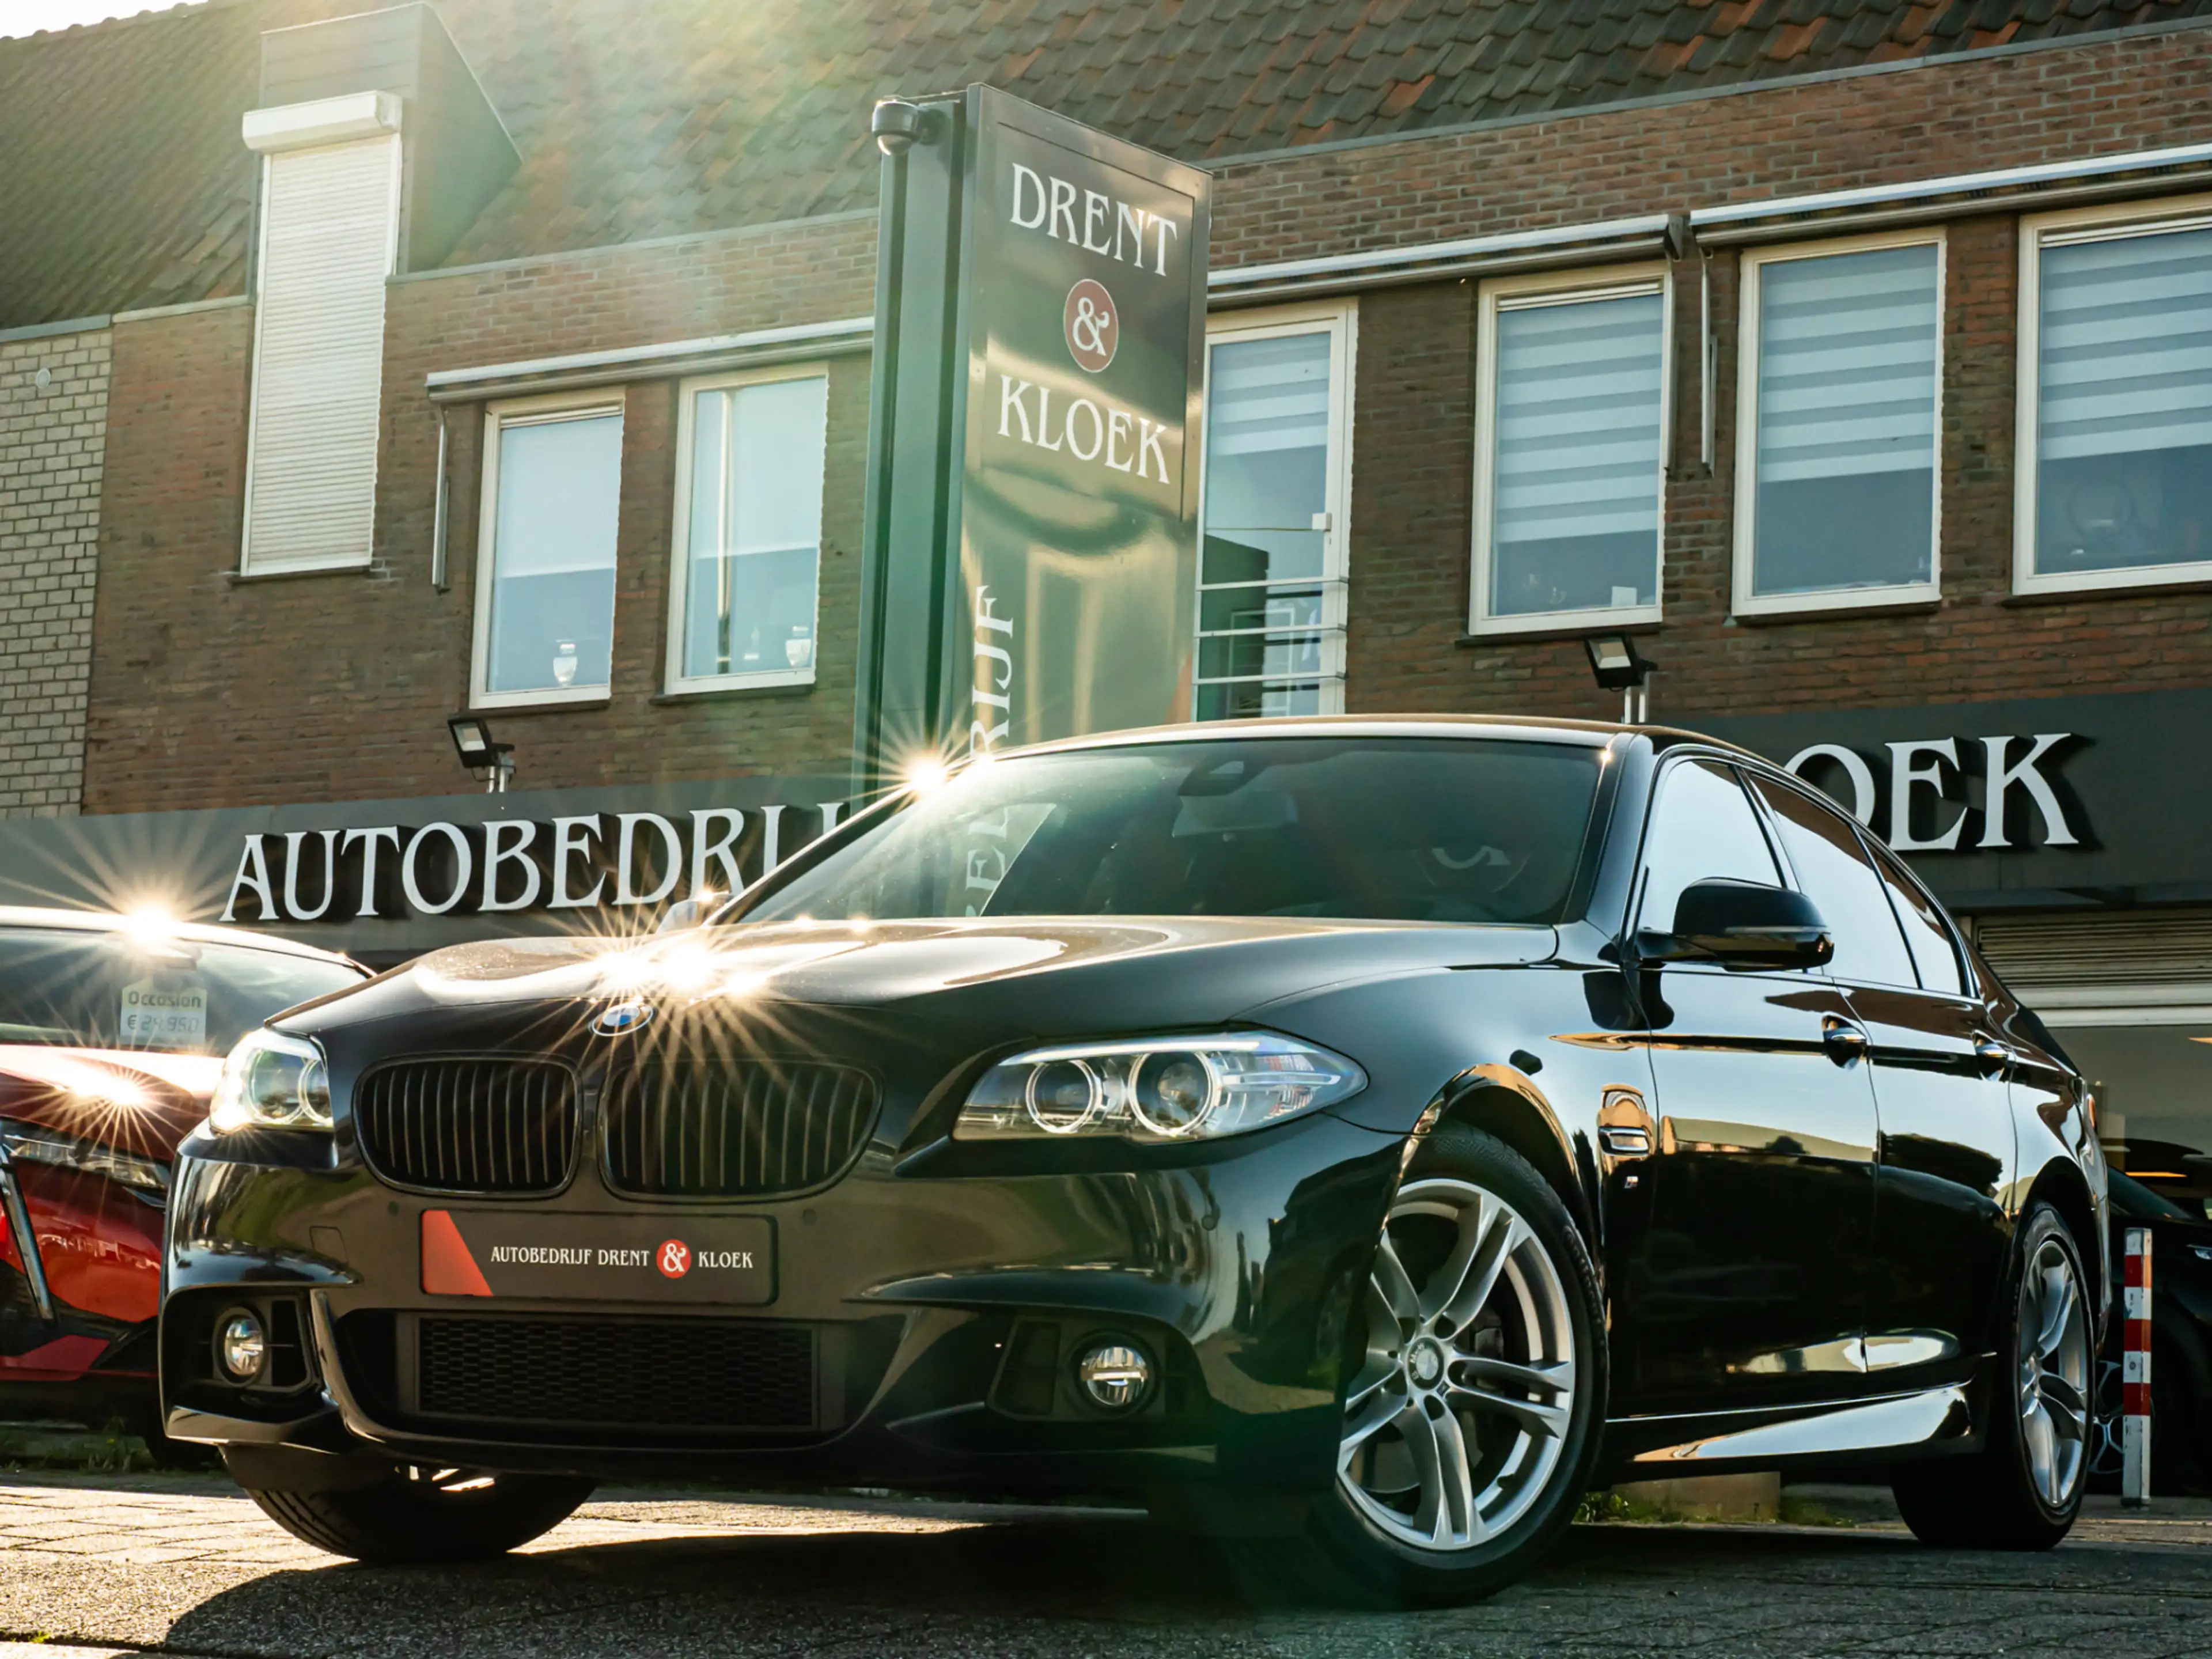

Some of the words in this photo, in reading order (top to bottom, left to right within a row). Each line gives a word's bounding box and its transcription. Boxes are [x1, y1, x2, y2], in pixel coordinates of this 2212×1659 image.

[1010, 162, 1177, 276] DRENT
[1073, 297, 1109, 357] &
[997, 374, 1171, 484] KLOEK
[128, 990, 201, 1008] Occasion
[491, 1246, 592, 1265] AUTOBEDRIJF
[598, 1249, 650, 1267] DRENT
[663, 1243, 687, 1272] &
[698, 1251, 753, 1268] KLOEK
